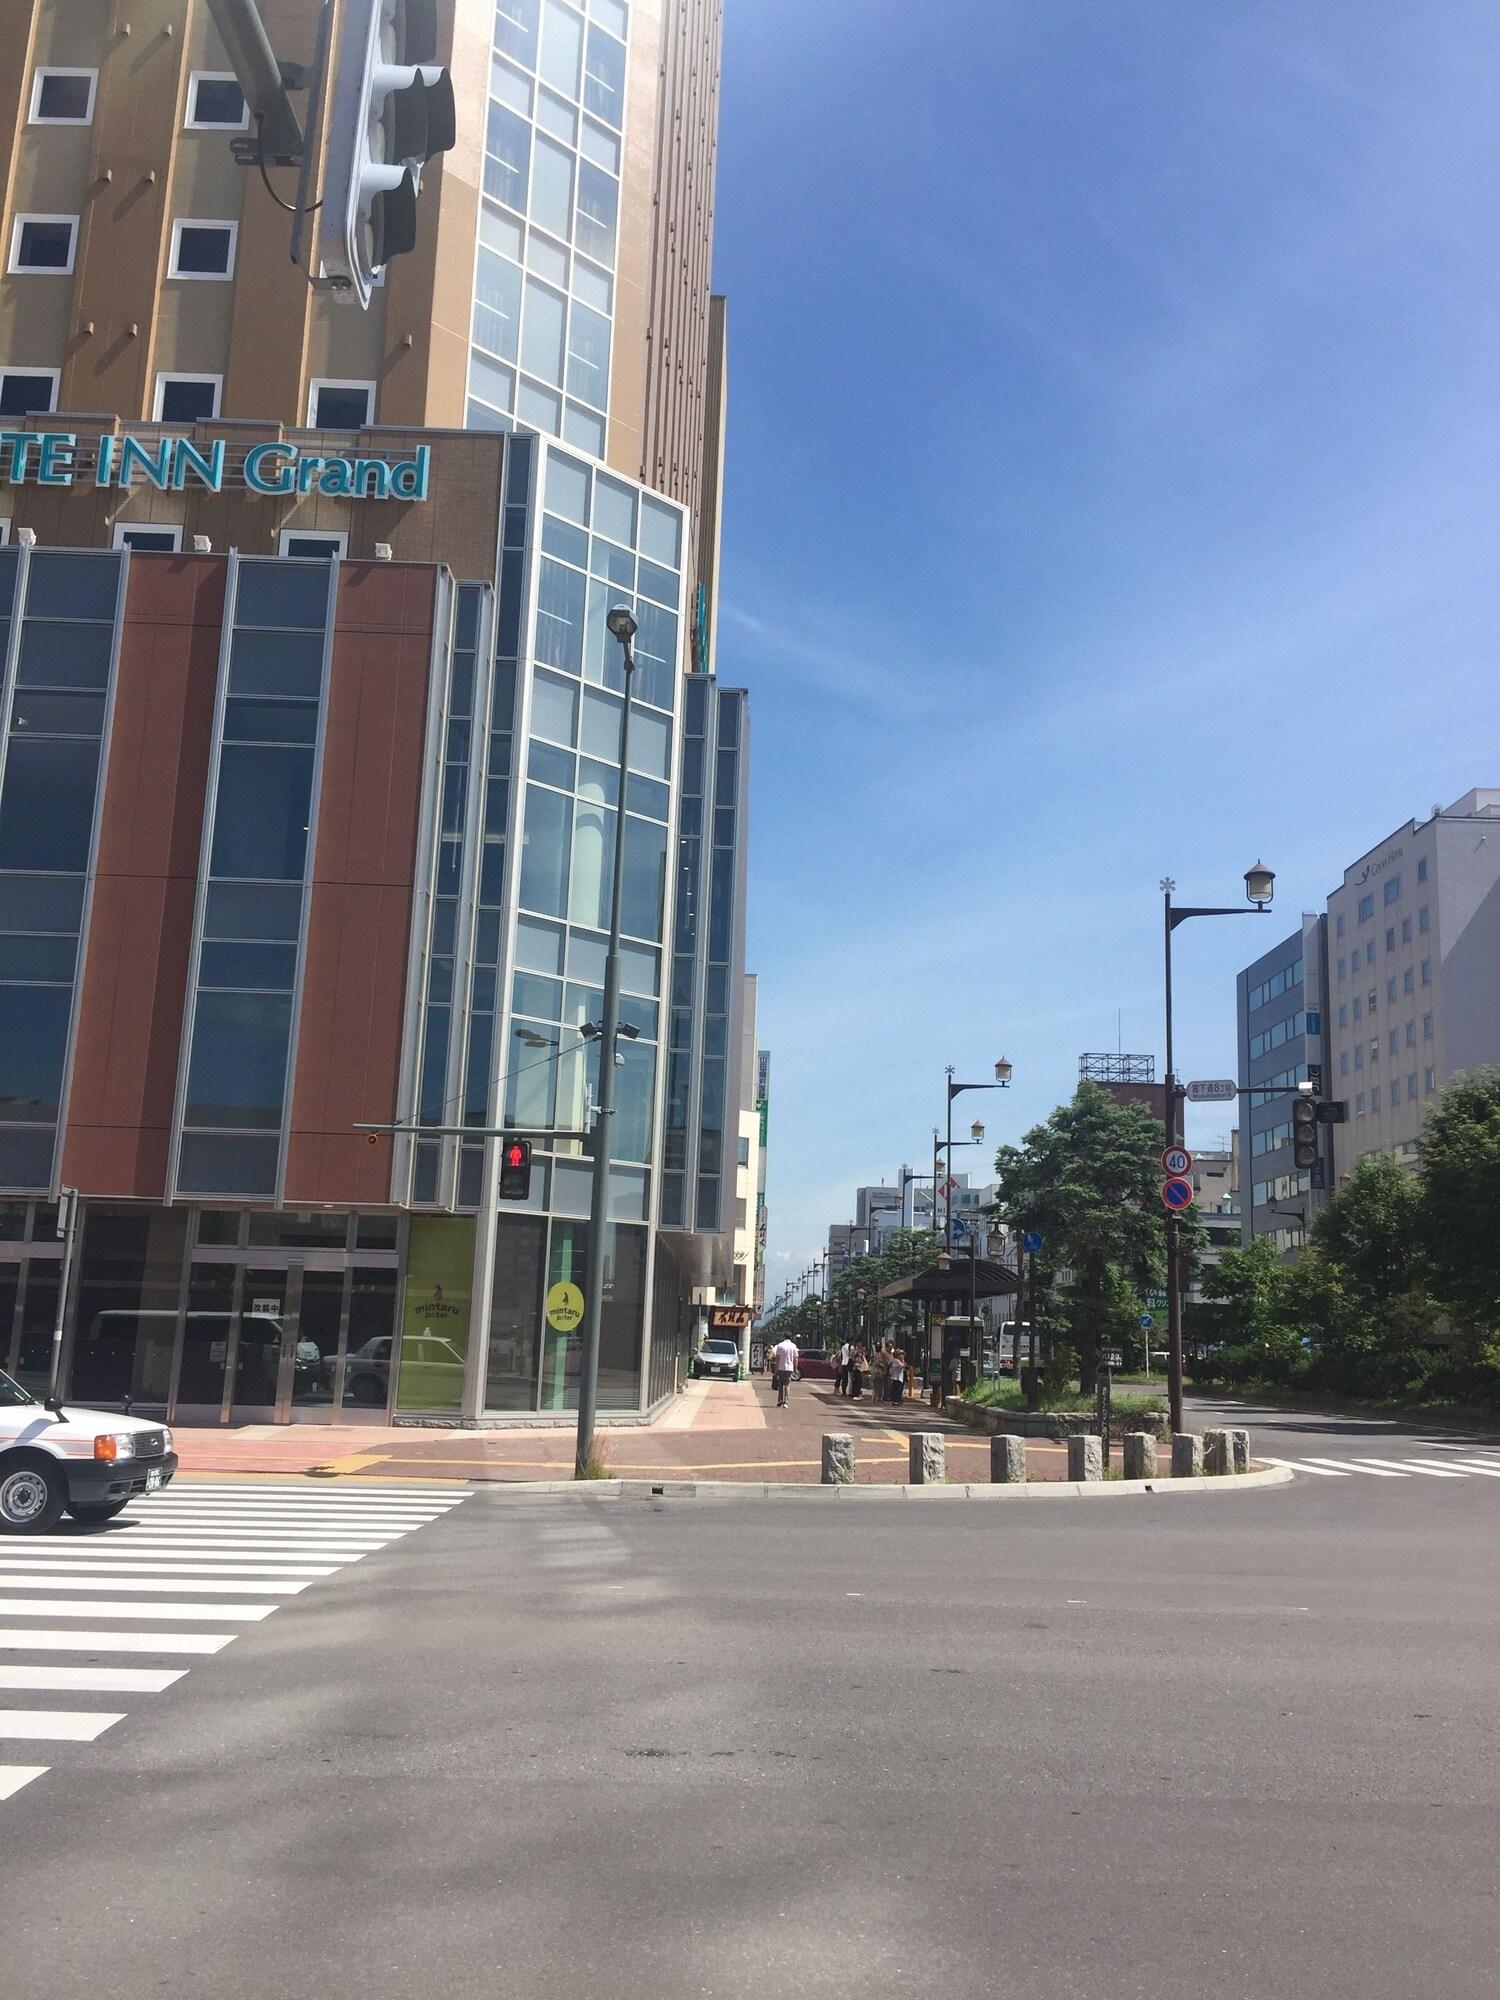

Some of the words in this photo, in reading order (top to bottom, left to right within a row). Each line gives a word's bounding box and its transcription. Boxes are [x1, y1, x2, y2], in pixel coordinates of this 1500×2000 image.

[0, 432, 76, 486] TE
[96, 434, 226, 493] INN
[243, 441, 431, 502] Grand
[1169, 1155, 1185, 1168] 40
[254, 1304, 279, 1313] 改装中
[415, 1302, 460, 1314] mintaru
[549, 1307, 580, 1318] mintaru
